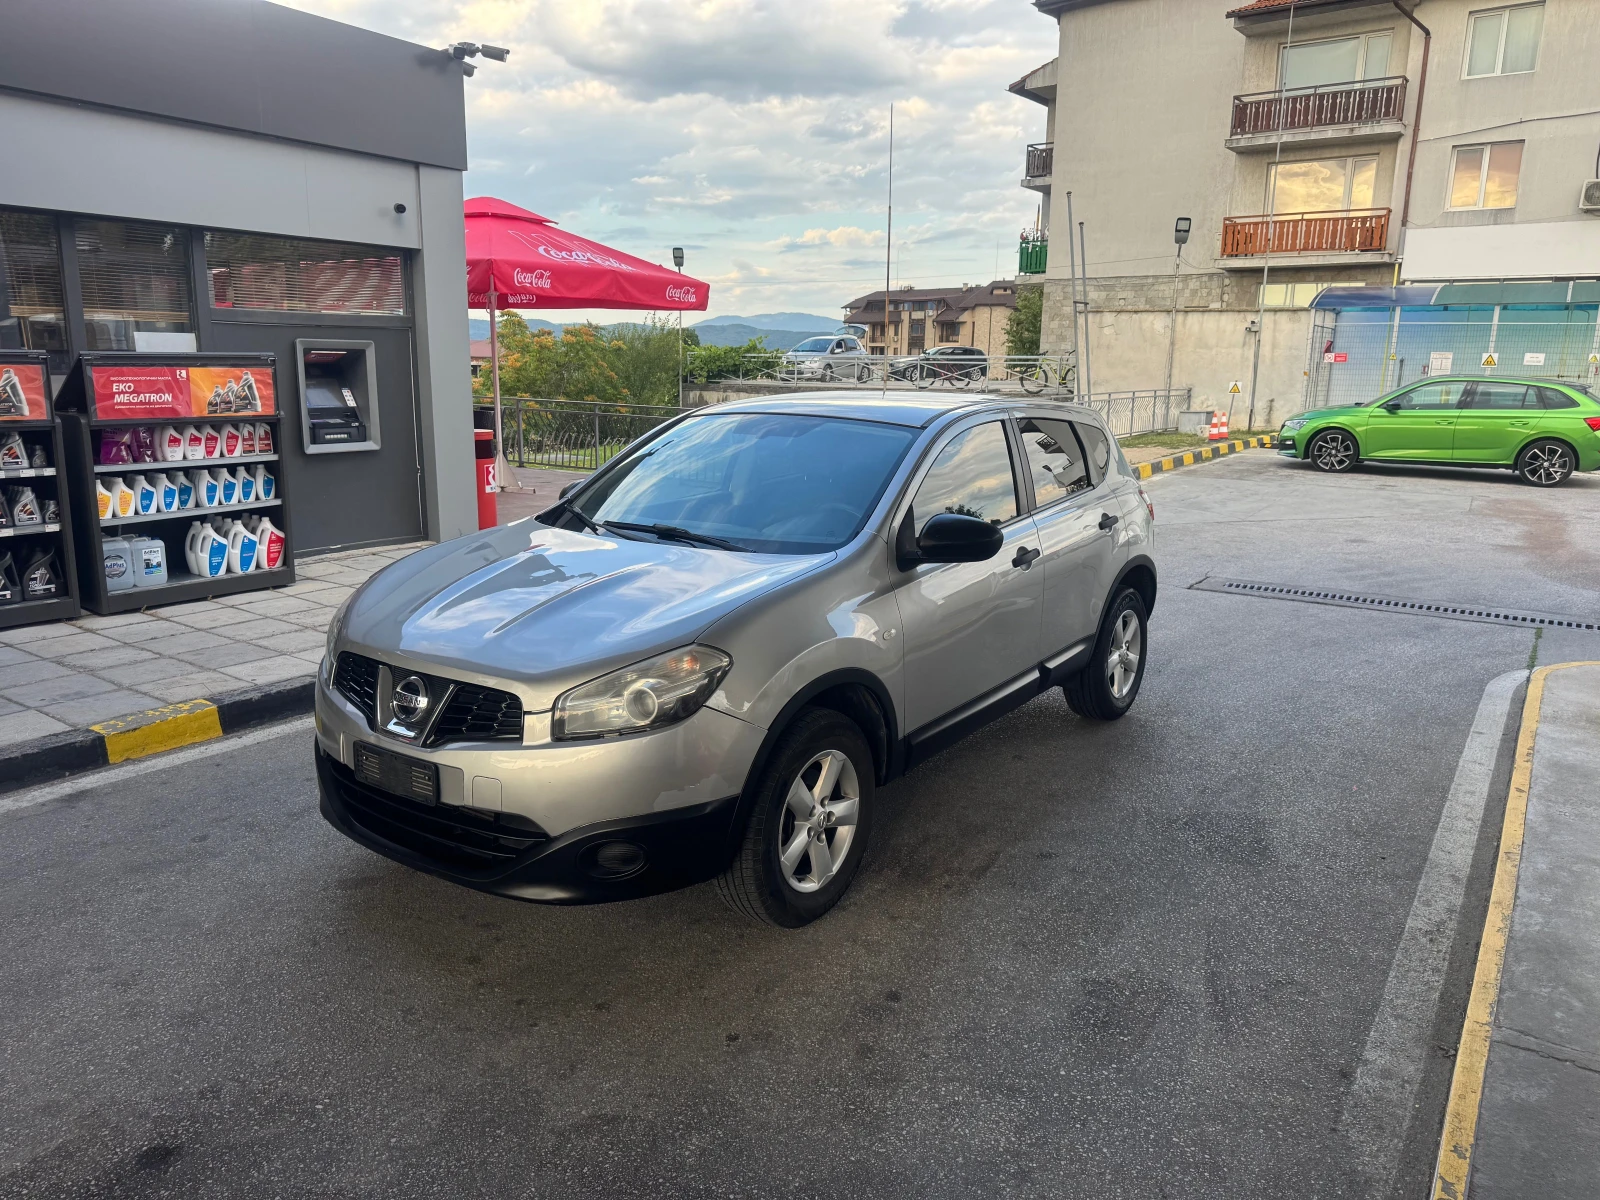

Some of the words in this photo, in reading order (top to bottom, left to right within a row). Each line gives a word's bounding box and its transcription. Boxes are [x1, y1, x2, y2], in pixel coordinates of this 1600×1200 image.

[514, 267, 551, 289] Coca-Cola
[665, 284, 697, 303] Coca-Cola
[112, 382, 135, 392] EKO
[114, 393, 173, 403] MEGATRON
